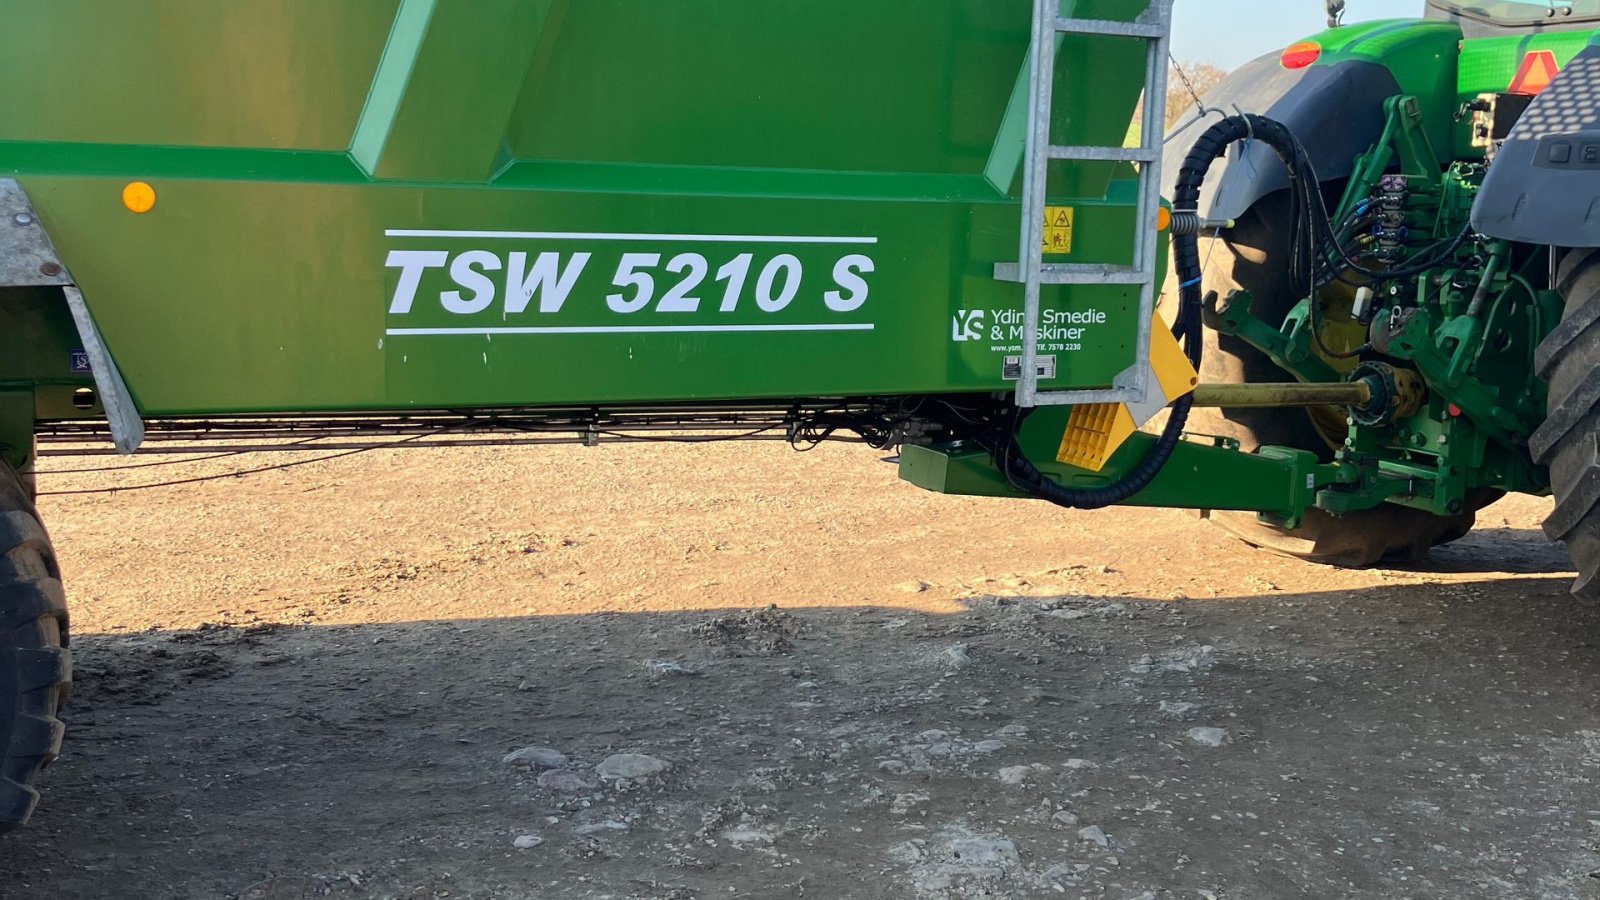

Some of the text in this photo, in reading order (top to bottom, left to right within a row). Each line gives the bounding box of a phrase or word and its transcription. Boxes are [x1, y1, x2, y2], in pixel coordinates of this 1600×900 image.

[384, 249, 875, 315] TSW 5210 S
[990, 308, 1107, 324] Ydin Smedie
[990, 325, 1085, 341] & Mskiner
[990, 344, 1024, 352] www.ysm.
[1048, 343, 1064, 351] 7578
[1065, 343, 1081, 351] 2230
